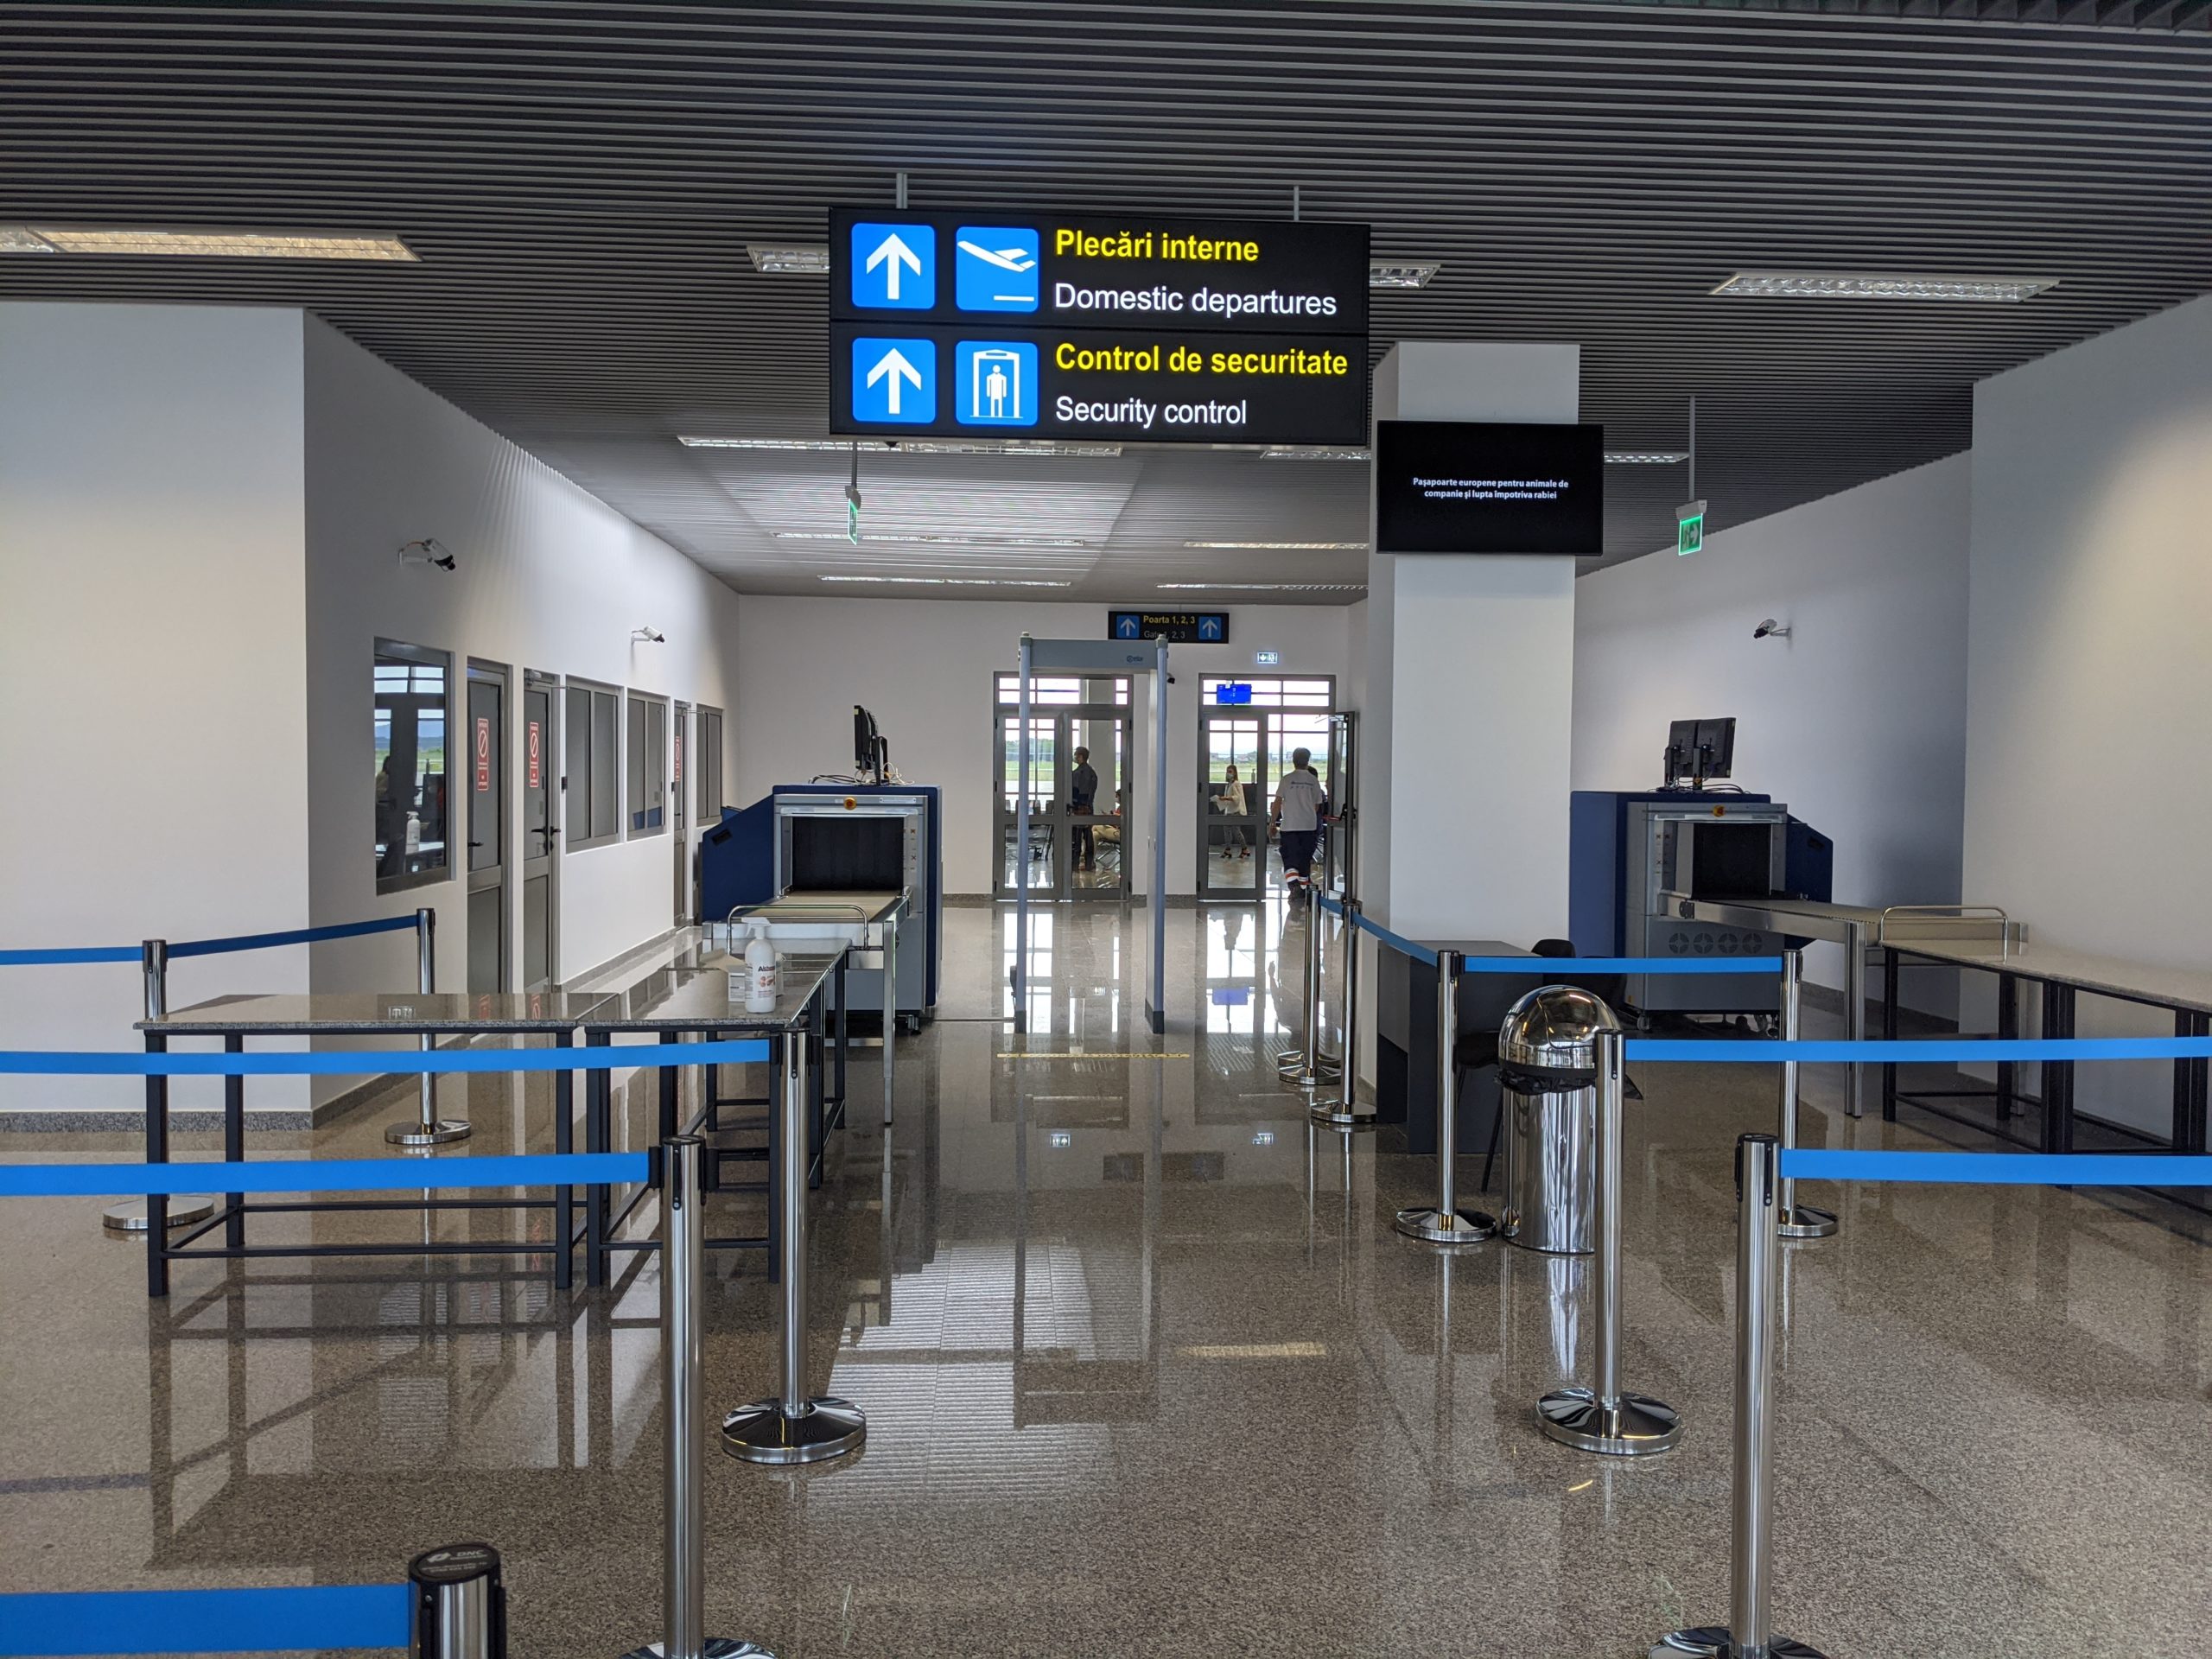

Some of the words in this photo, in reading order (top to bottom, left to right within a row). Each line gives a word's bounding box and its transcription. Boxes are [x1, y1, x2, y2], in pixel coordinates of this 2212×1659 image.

[1056, 229, 1153, 258] Plecări
[1162, 232, 1259, 262] interne
[1055, 282, 1184, 311] Domestic
[1192, 287, 1338, 319] departures
[1056, 342, 1159, 372] Control
[1168, 346, 1202, 372] de
[1211, 348, 1348, 375] securitate
[1056, 395, 1157, 429] Security
[1164, 399, 1247, 424] control
[1424, 489, 1464, 499] companie
[1471, 489, 1493, 499] lupta
[1534, 491, 1557, 499] rabiei
[1459, 479, 1497, 488] europene
[1497, 480, 1524, 488] pentru
[1525, 480, 1557, 488] animale
[1558, 480, 1569, 488] de
[1143, 614, 1170, 623] Poarta
[1172, 616, 1179, 626] 1,
[1180, 616, 1189, 625] 2,
[1180, 631, 1186, 639] 3
